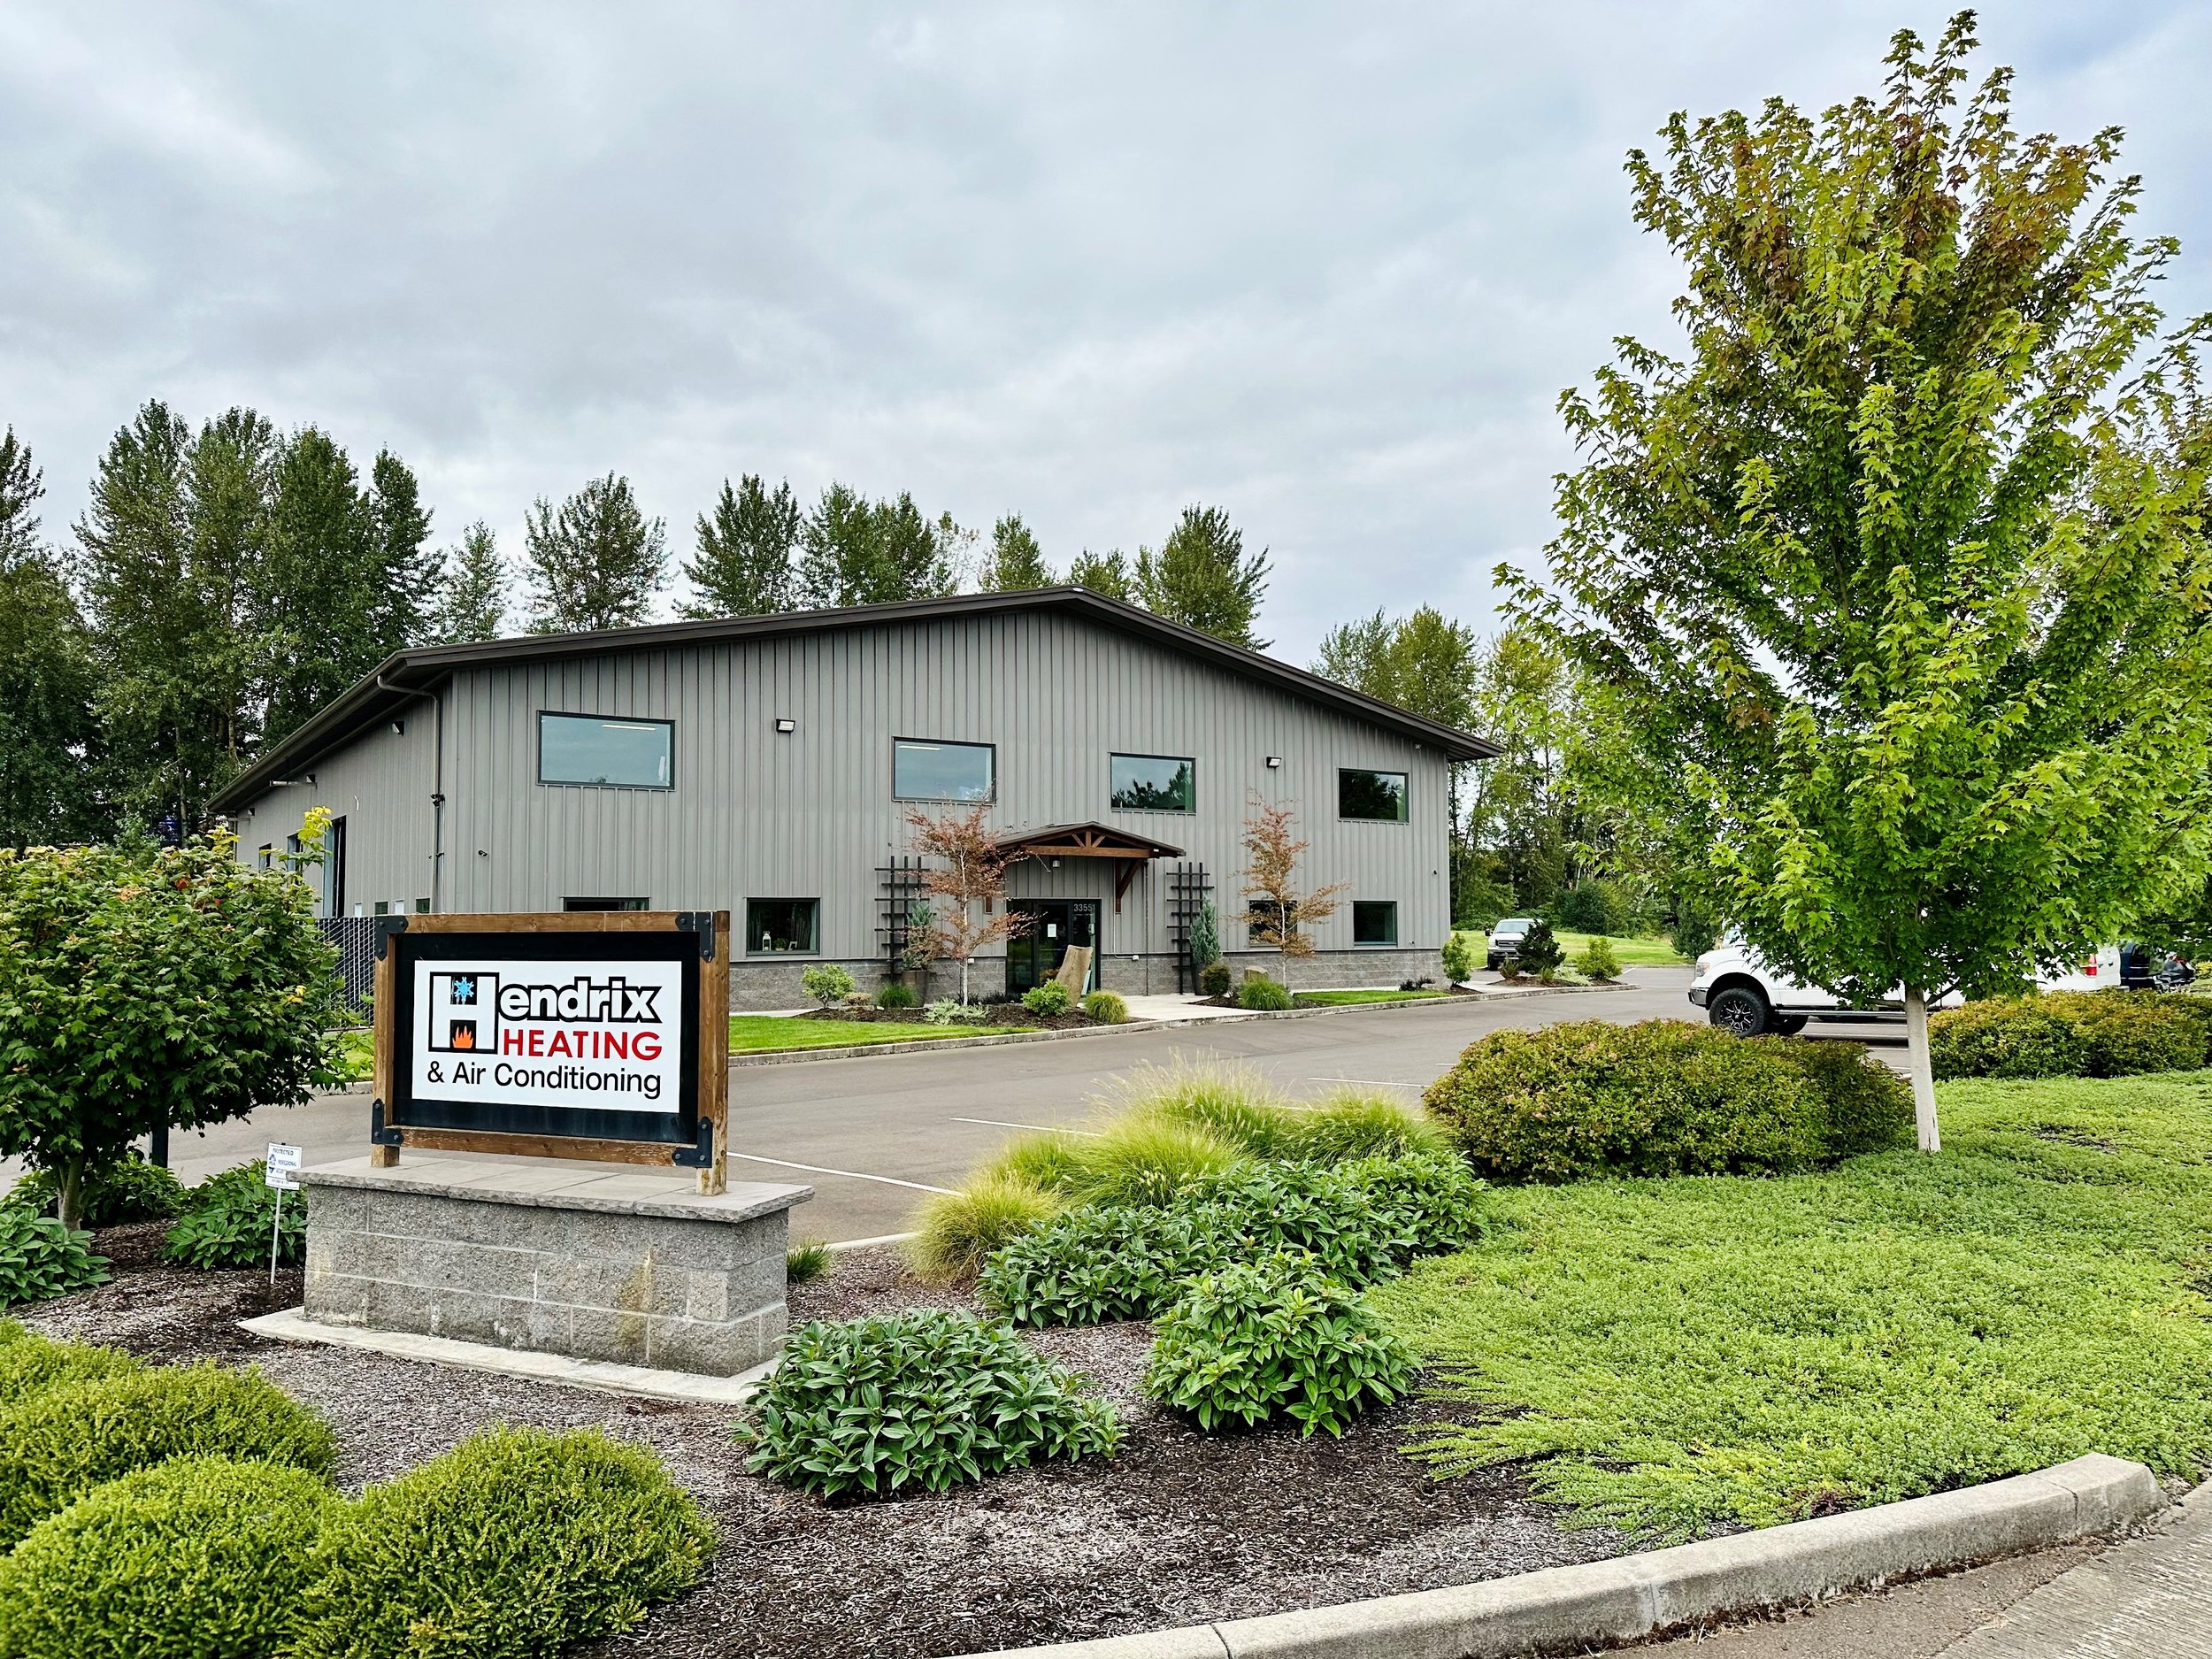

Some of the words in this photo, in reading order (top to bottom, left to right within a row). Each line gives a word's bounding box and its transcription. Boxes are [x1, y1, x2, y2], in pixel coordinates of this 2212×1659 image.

[428, 972, 663, 1055] Hendrix
[503, 1029, 663, 1061] HEATING
[426, 1061, 444, 1084] &
[452, 1062, 486, 1085] Air
[494, 1063, 661, 1100] Conditioning
